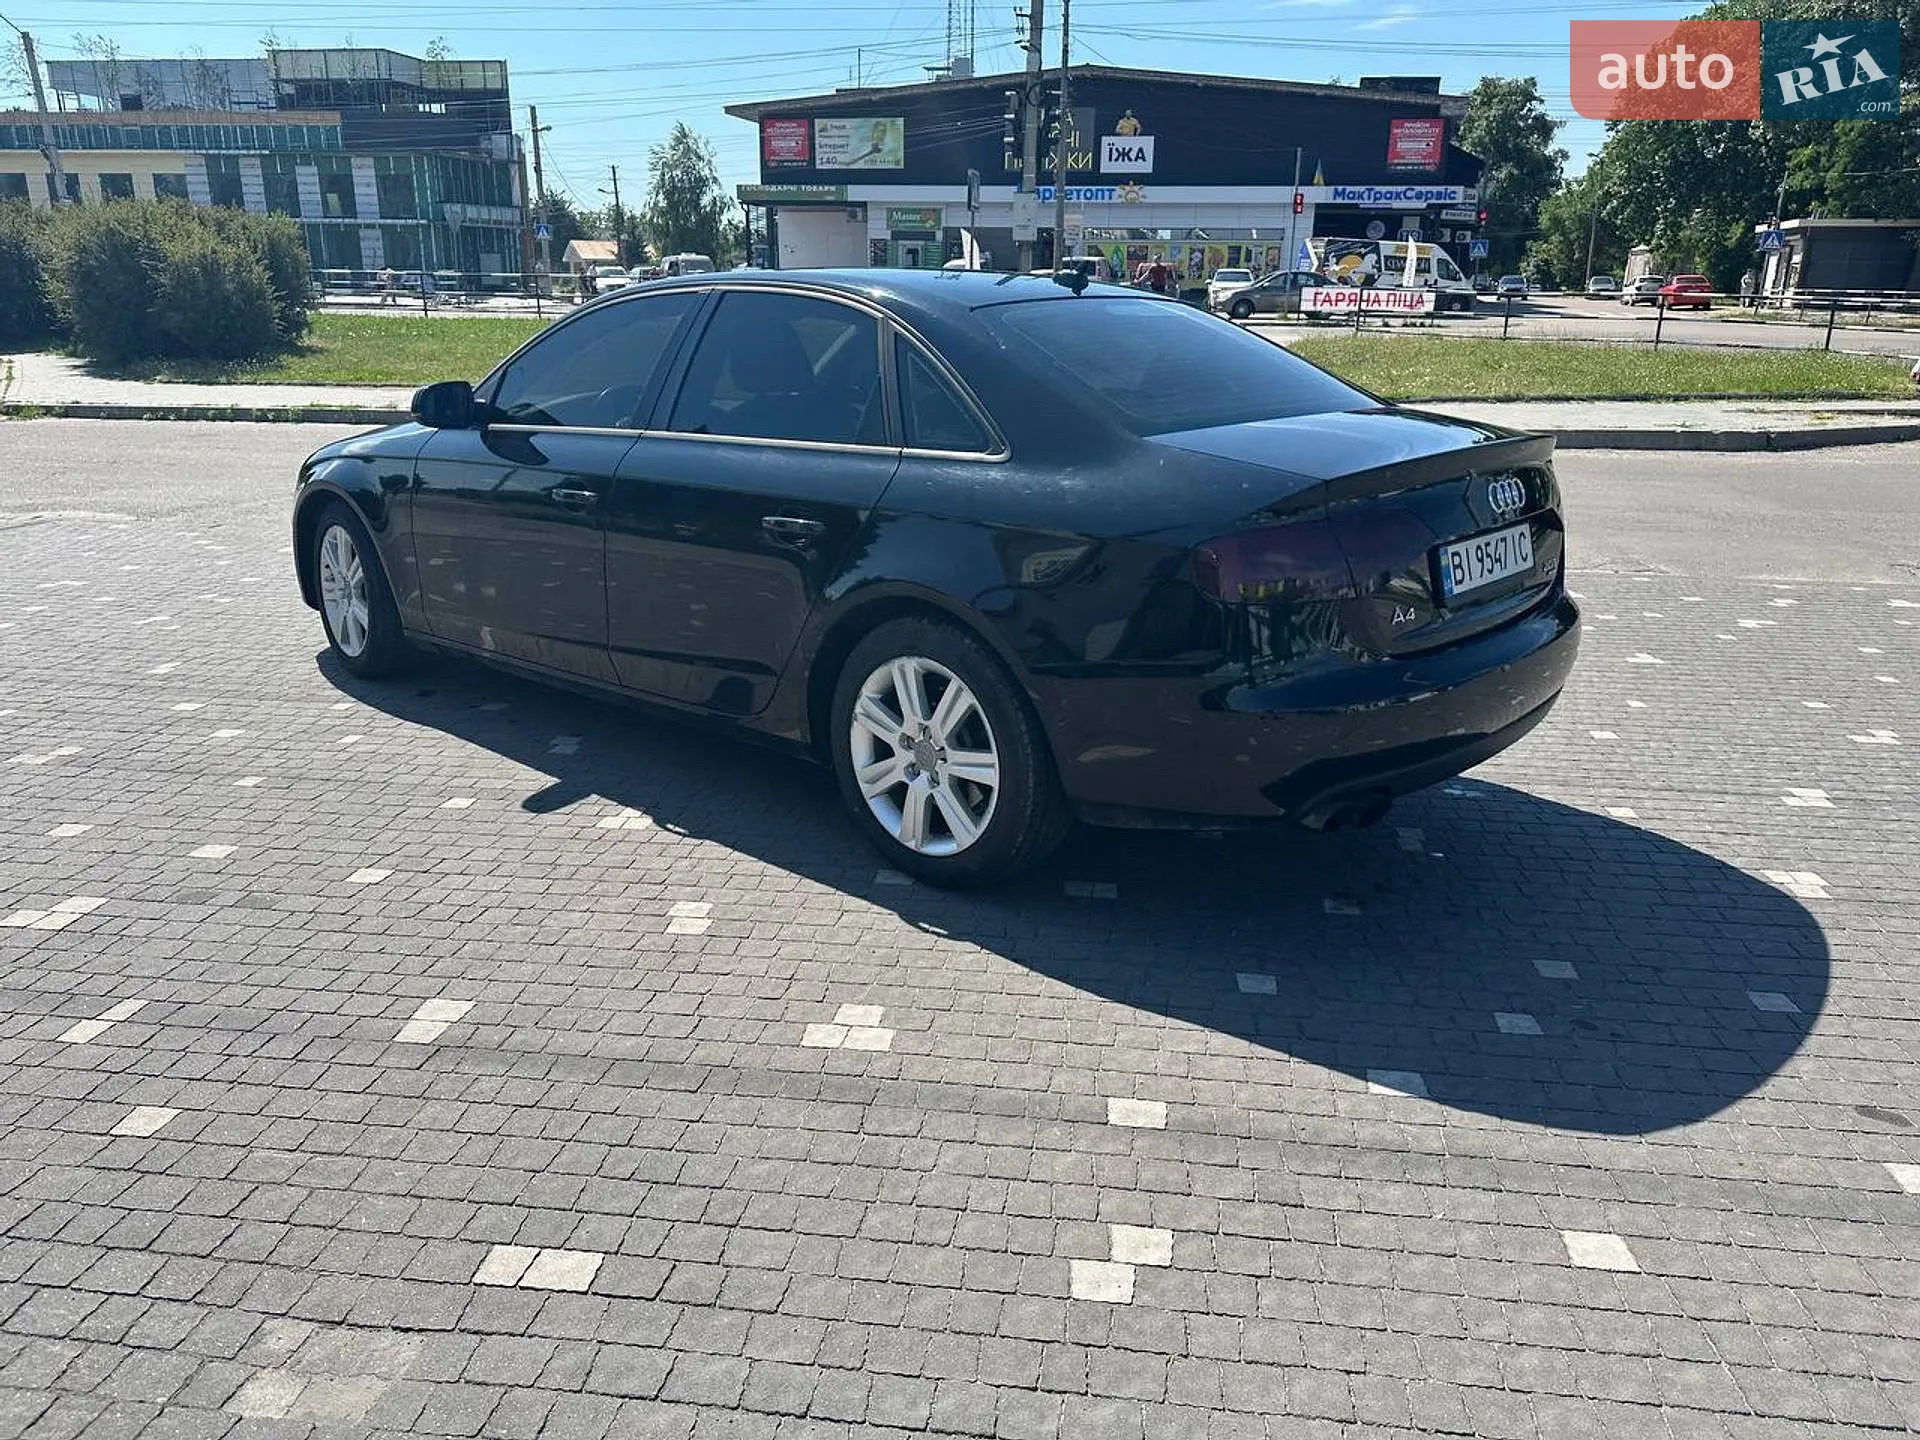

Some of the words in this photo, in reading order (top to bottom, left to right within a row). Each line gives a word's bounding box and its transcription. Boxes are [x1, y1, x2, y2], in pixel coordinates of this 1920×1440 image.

[1107, 142, 1146, 162] ЇЖА
[1313, 291, 1381, 307] ГАРЯЧА
[1386, 292, 1425, 310] ПІЦА
[1451, 547, 1473, 586] BI
[1475, 536, 1507, 578] 9547
[1512, 531, 1528, 565] IC
[1392, 606, 1416, 625] A4
